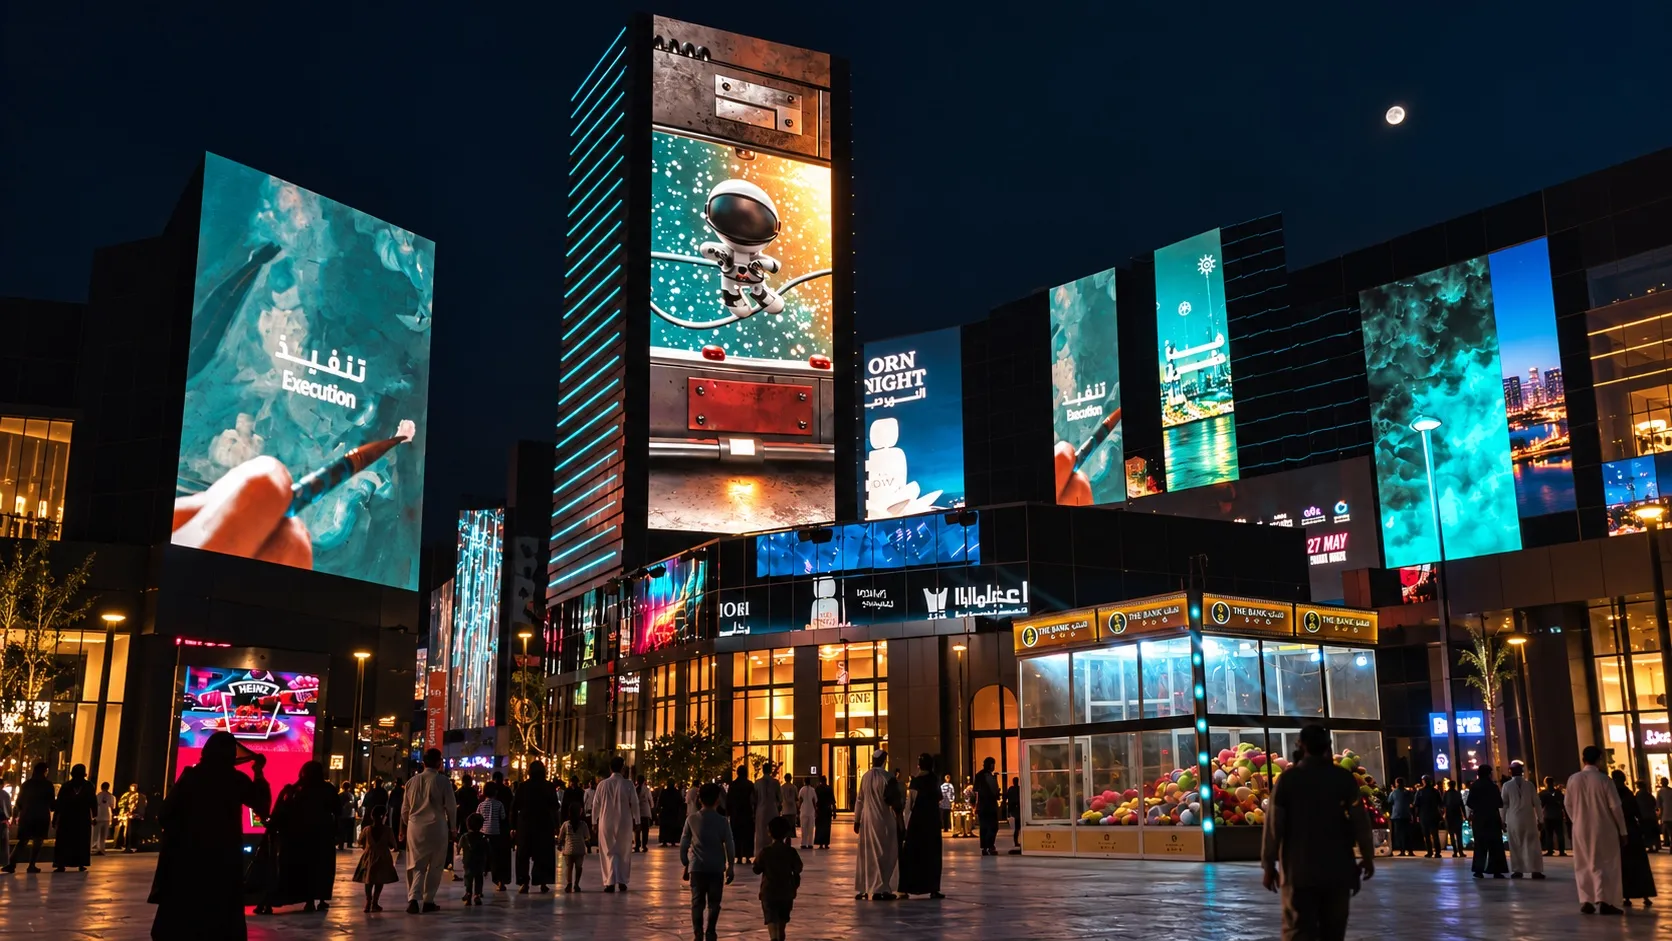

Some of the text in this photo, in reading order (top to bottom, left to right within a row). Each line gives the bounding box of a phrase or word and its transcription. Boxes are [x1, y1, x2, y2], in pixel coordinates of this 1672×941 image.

[275, 335, 366, 382] تنفيذ
[868, 351, 916, 374] ORN
[282, 369, 356, 409] Execution
[1307, 533, 1348, 554] 27 MAY
[239, 684, 270, 695] HEINZ
